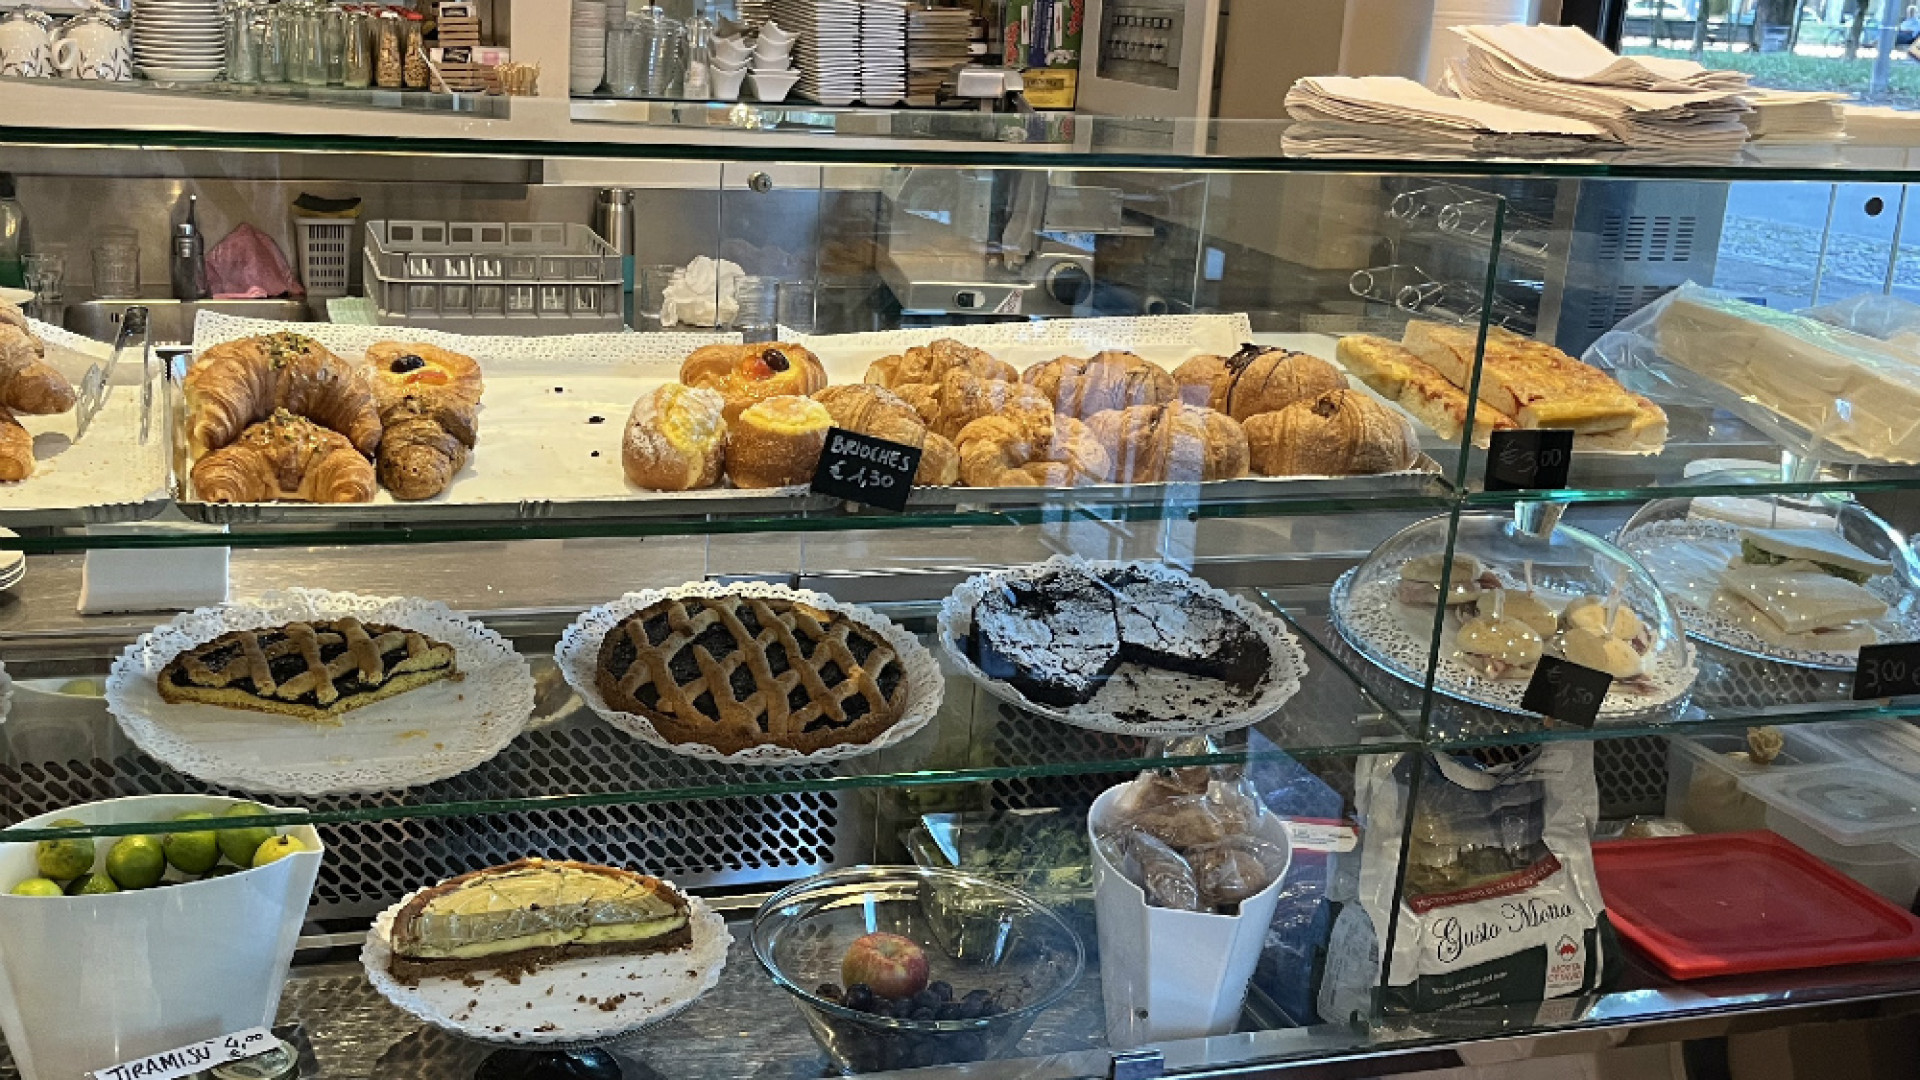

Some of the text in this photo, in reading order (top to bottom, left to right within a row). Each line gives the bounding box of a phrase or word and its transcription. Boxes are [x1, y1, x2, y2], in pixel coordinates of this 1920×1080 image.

[831, 435, 911, 471] BRIOCHES
[1432, 898, 1574, 963] Gusto Motta
